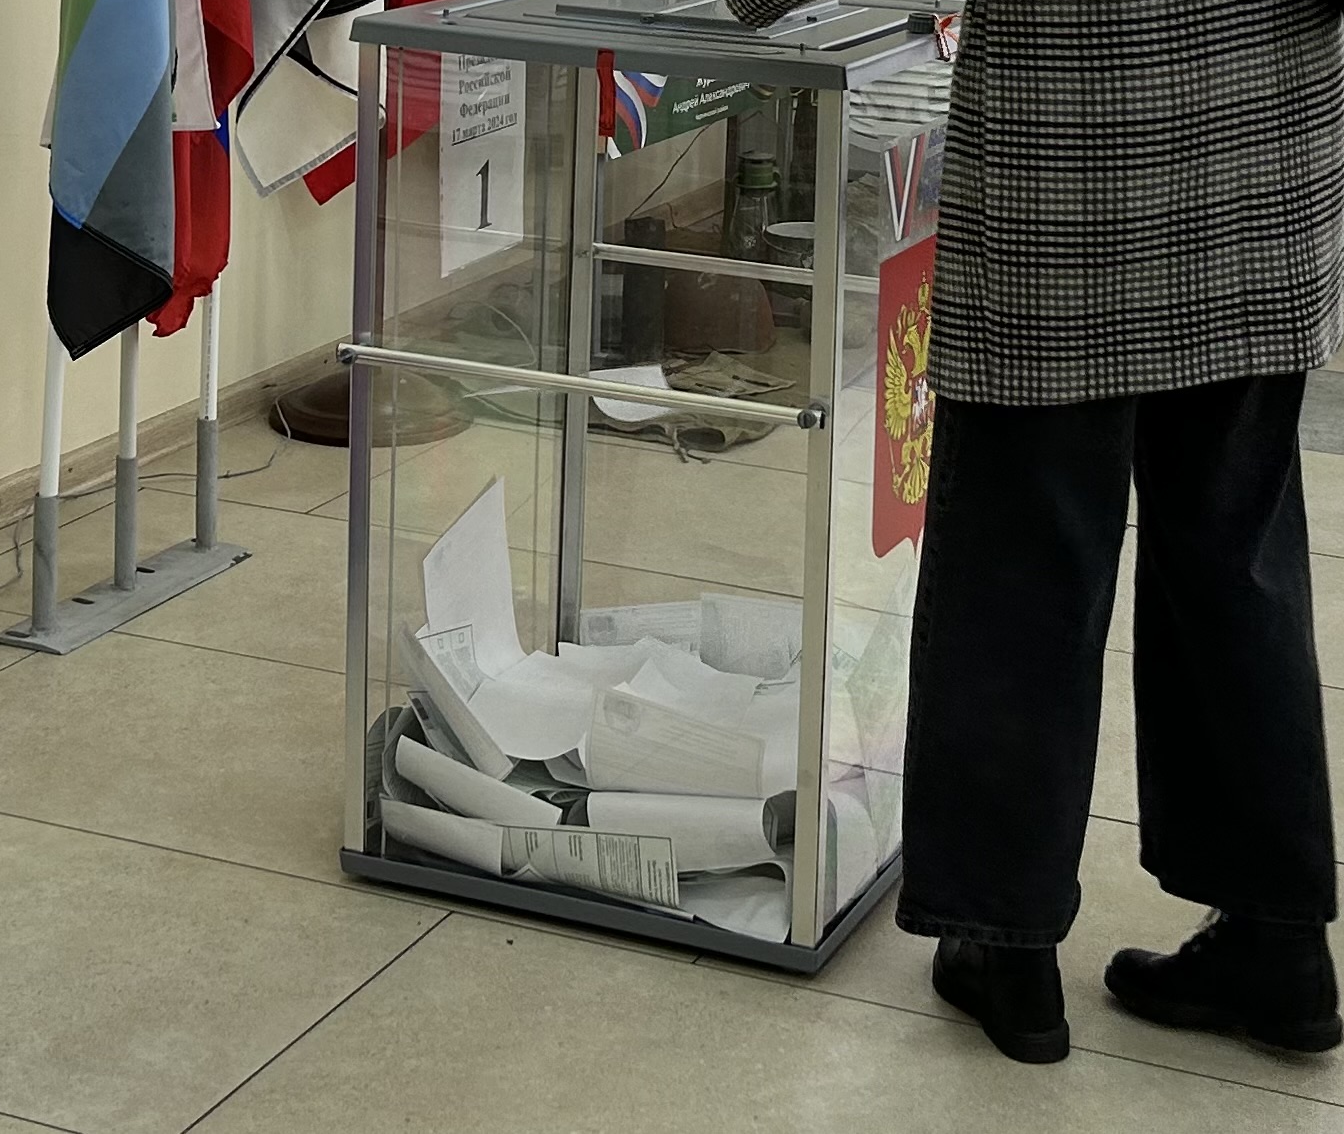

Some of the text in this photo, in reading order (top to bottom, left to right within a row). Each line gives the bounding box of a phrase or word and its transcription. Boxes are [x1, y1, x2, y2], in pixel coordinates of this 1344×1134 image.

[458, 66, 511, 95] Российской
[459, 93, 510, 118] Федерации
[452, 127, 461, 142] 17
[488, 114, 504, 131] 2024
[476, 158, 492, 231] 1
